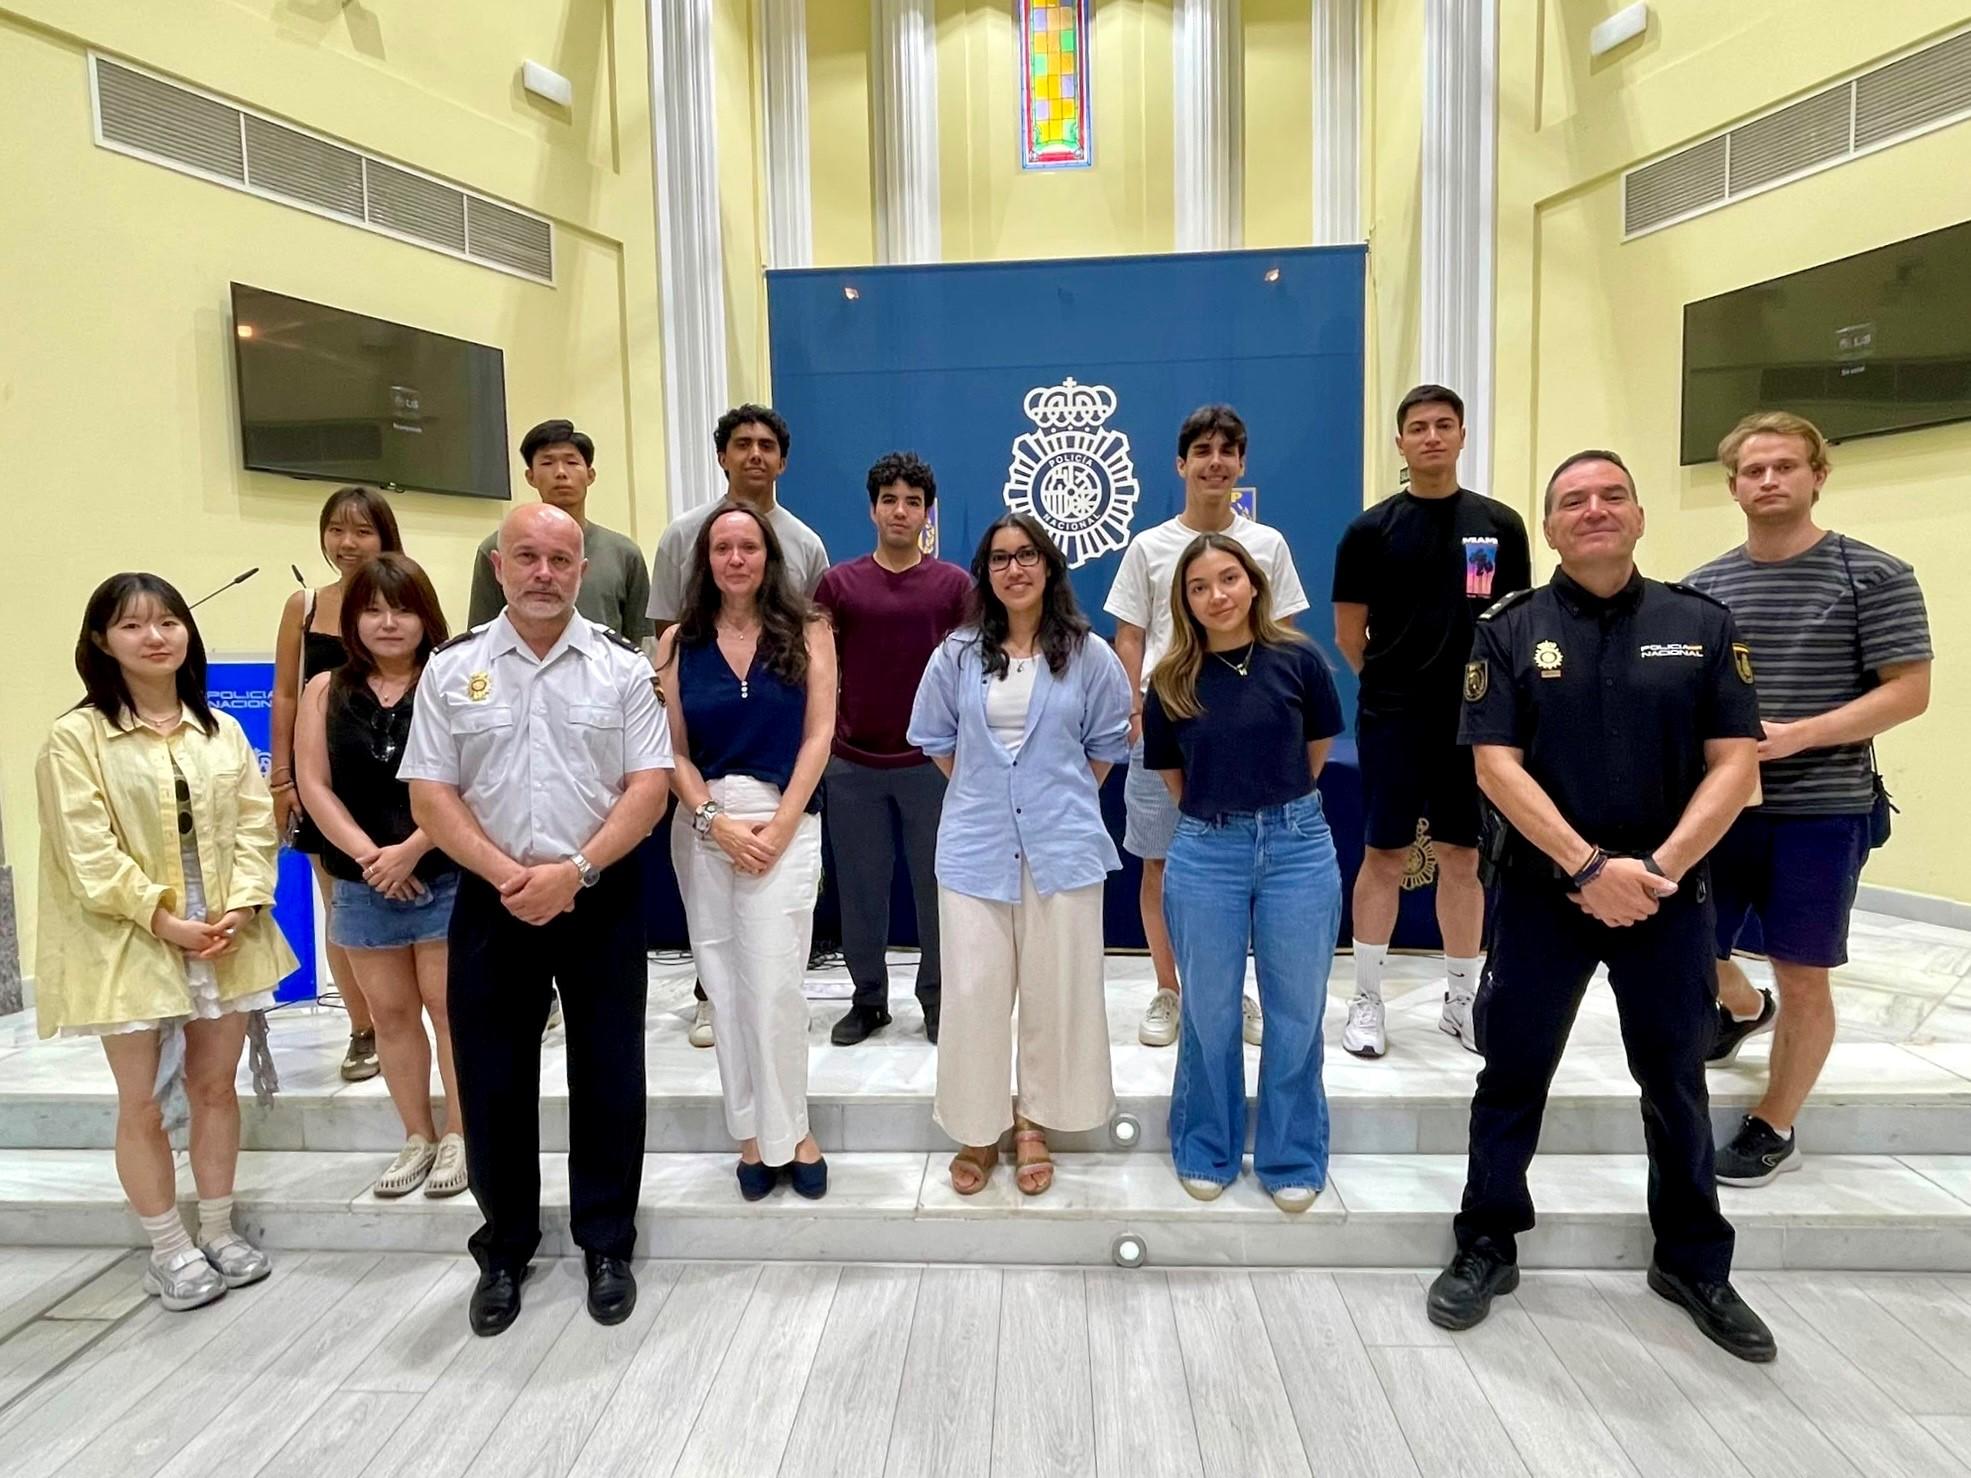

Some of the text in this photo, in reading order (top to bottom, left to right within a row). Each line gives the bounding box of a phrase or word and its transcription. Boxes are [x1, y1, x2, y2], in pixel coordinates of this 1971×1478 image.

[1043, 513, 1101, 530] NACIONAL
[1462, 536, 1499, 545] MIAMI
[1640, 643, 1689, 652] POLICIA
[1641, 649, 1704, 659] NACIONAL
[207, 700, 272, 708] NACION
